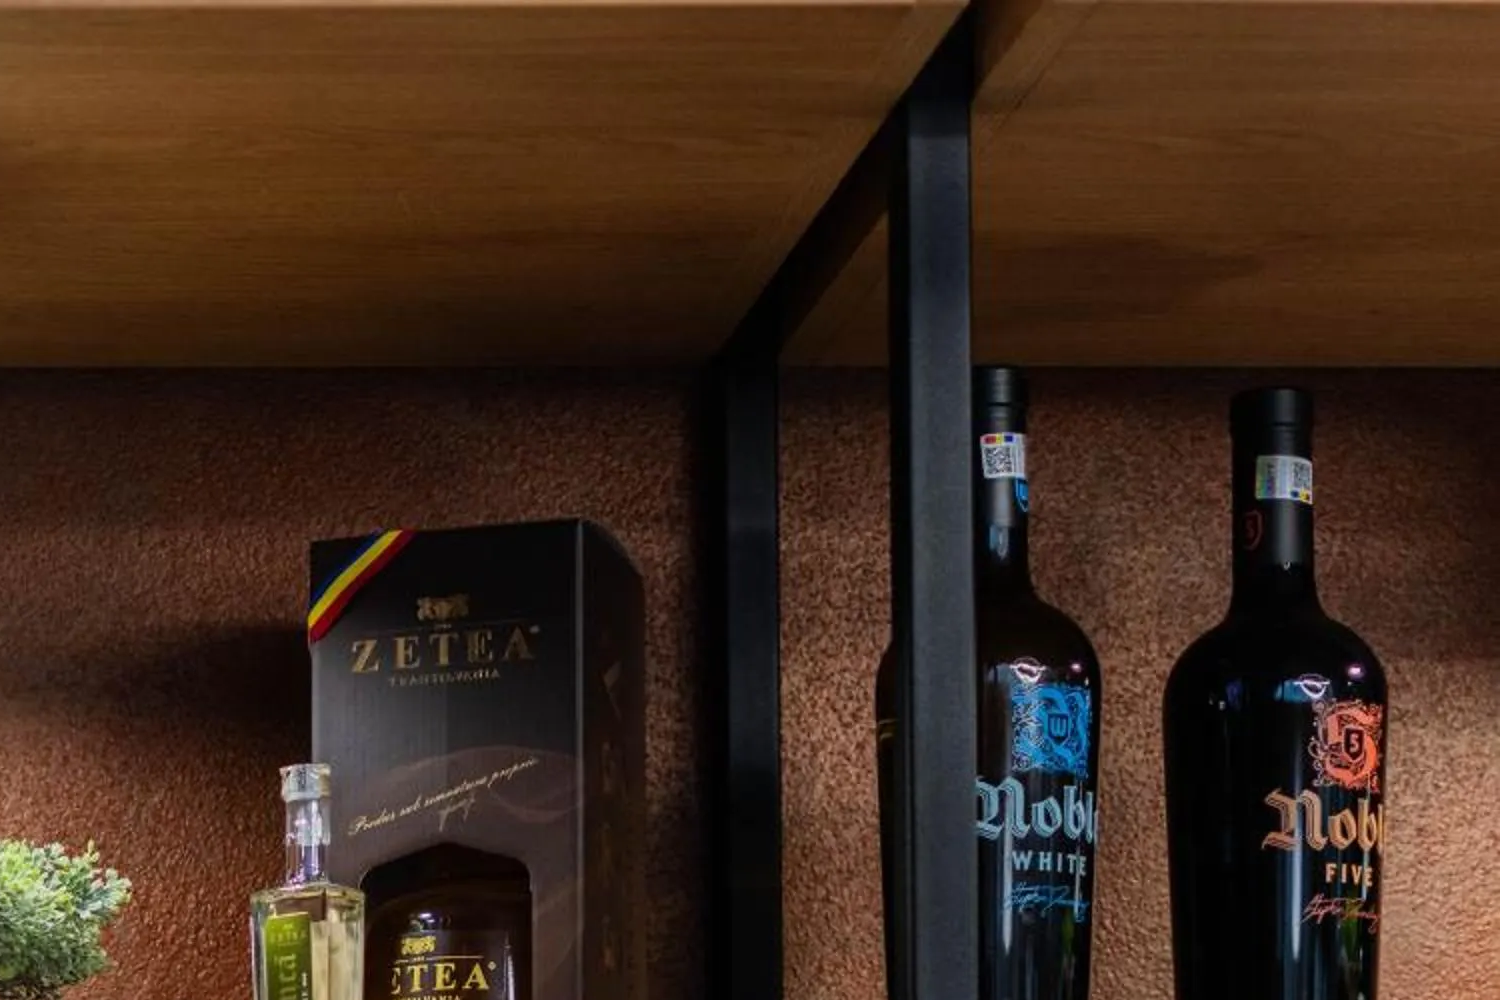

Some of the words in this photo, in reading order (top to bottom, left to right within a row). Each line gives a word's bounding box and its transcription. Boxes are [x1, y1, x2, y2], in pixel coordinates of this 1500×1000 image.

[351, 625, 535, 673] ZETEA
[975, 775, 1099, 844] Nobl
[1260, 787, 1384, 854] Nobl
[1012, 850, 1087, 877] WHITE
[1325, 862, 1373, 888] FIVE
